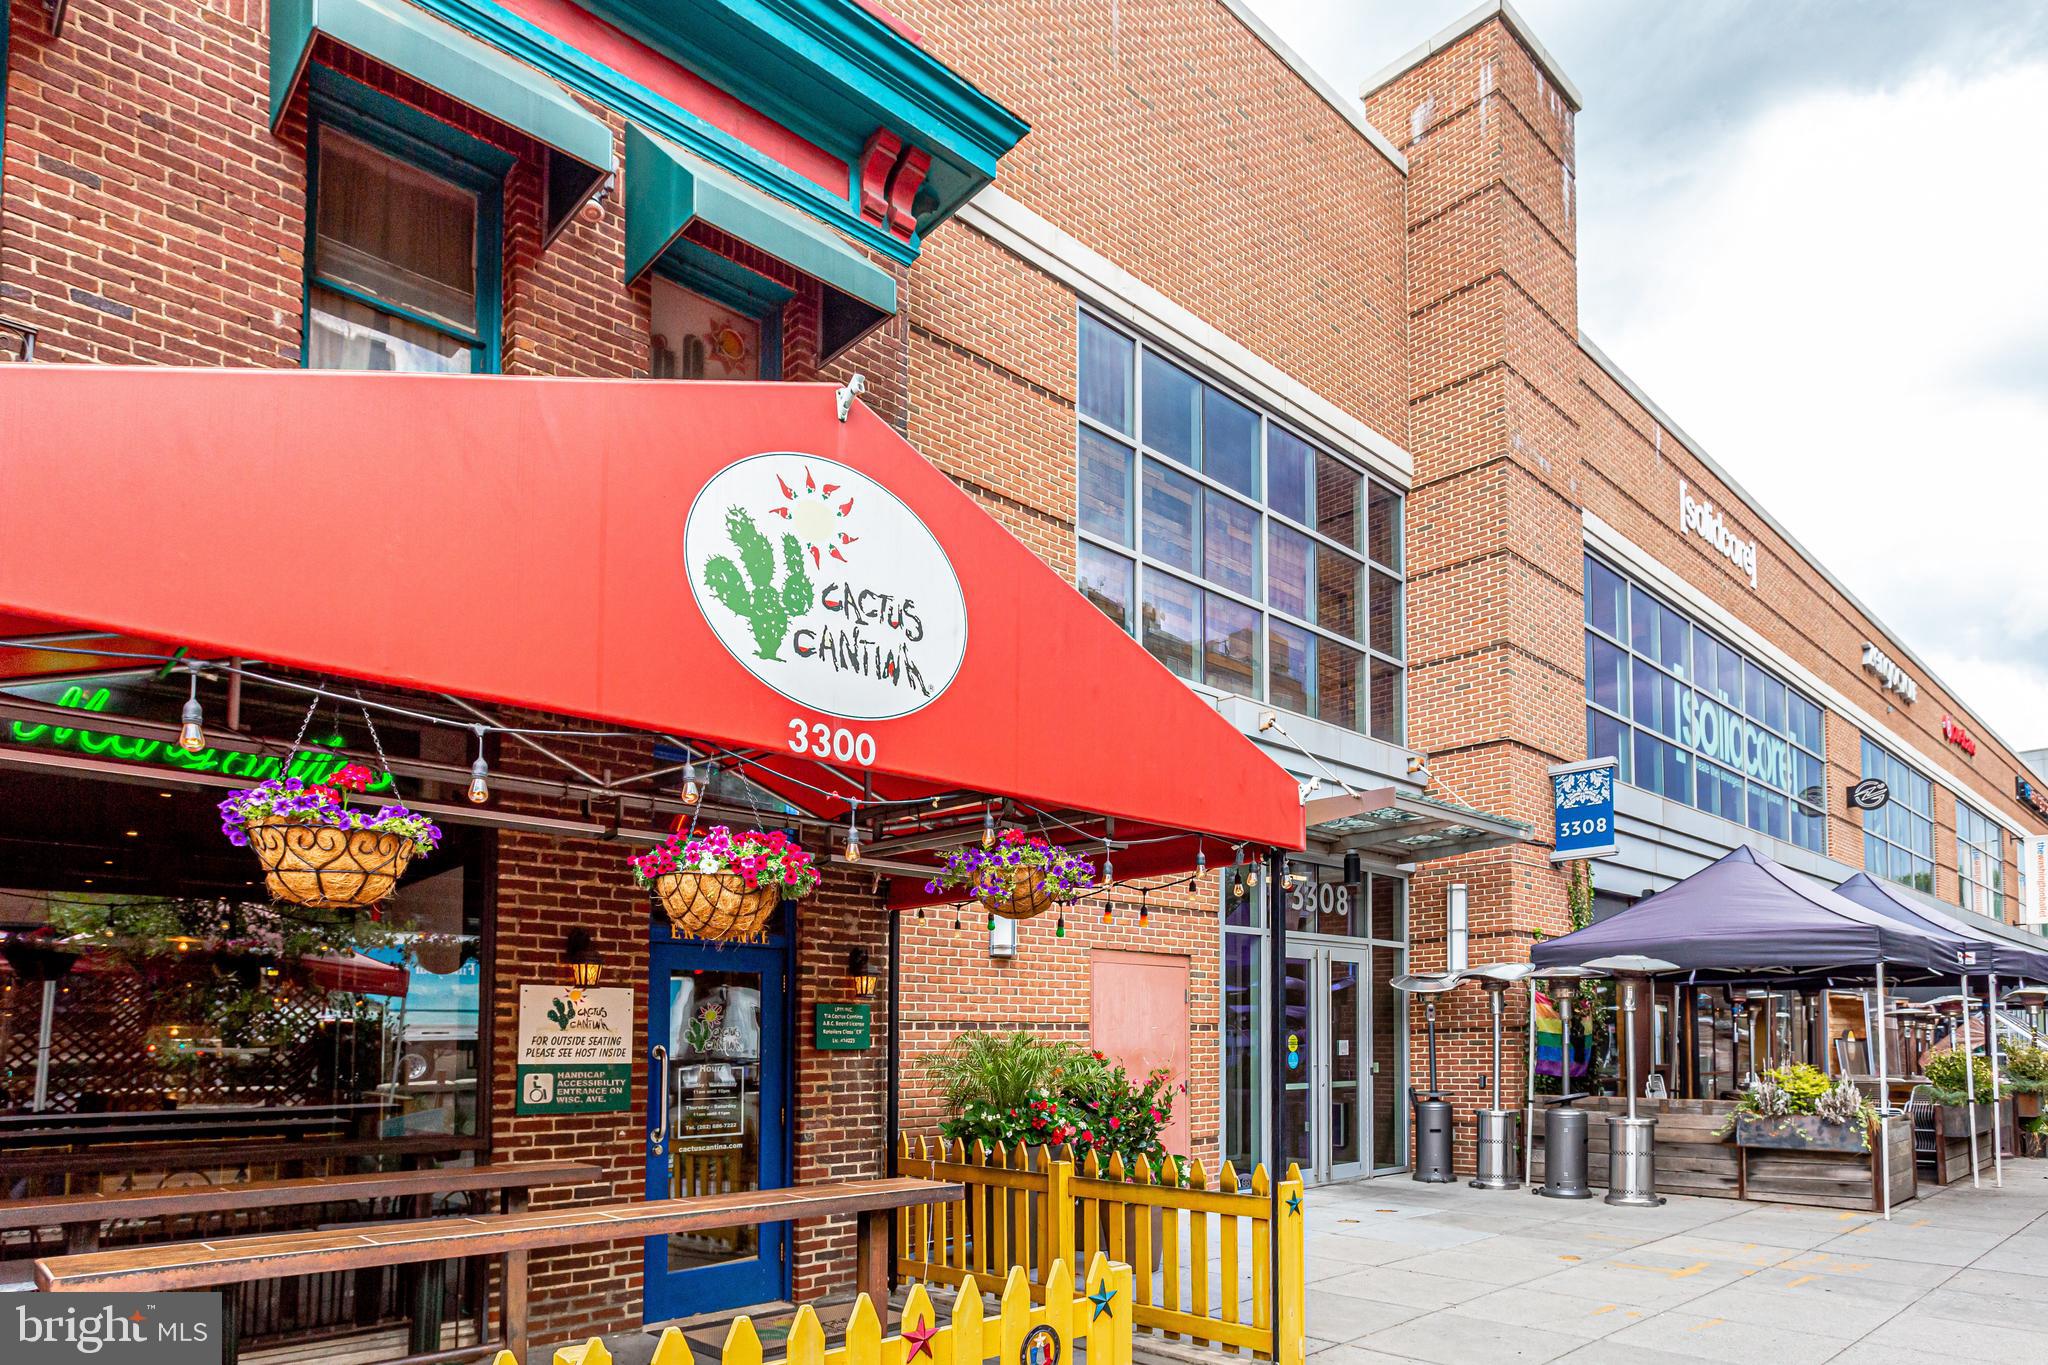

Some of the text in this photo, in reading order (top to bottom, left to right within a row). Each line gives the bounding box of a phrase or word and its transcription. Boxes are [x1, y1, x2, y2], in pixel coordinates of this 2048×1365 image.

[821, 582, 923, 642] CACTUS
[794, 626, 930, 697] CANTINA
[788, 718, 876, 765] 3300
[1559, 817, 1608, 838] 3308
[1290, 879, 1349, 917] 3308
[577, 1007, 608, 1018] CACTUS
[570, 1018, 609, 1030] CANTINA
[532, 1036, 621, 1046] FOR OUTSIDE SEATING
[526, 1048, 626, 1058] PLEASE SEE HOST INSIDE
[700, 1064, 727, 1072] Hours
[557, 1079, 626, 1087] ACCESSIBILITY
[557, 1087, 607, 1095] ENTRANCE
[678, 1143, 743, 1152] cactuscantina.com
